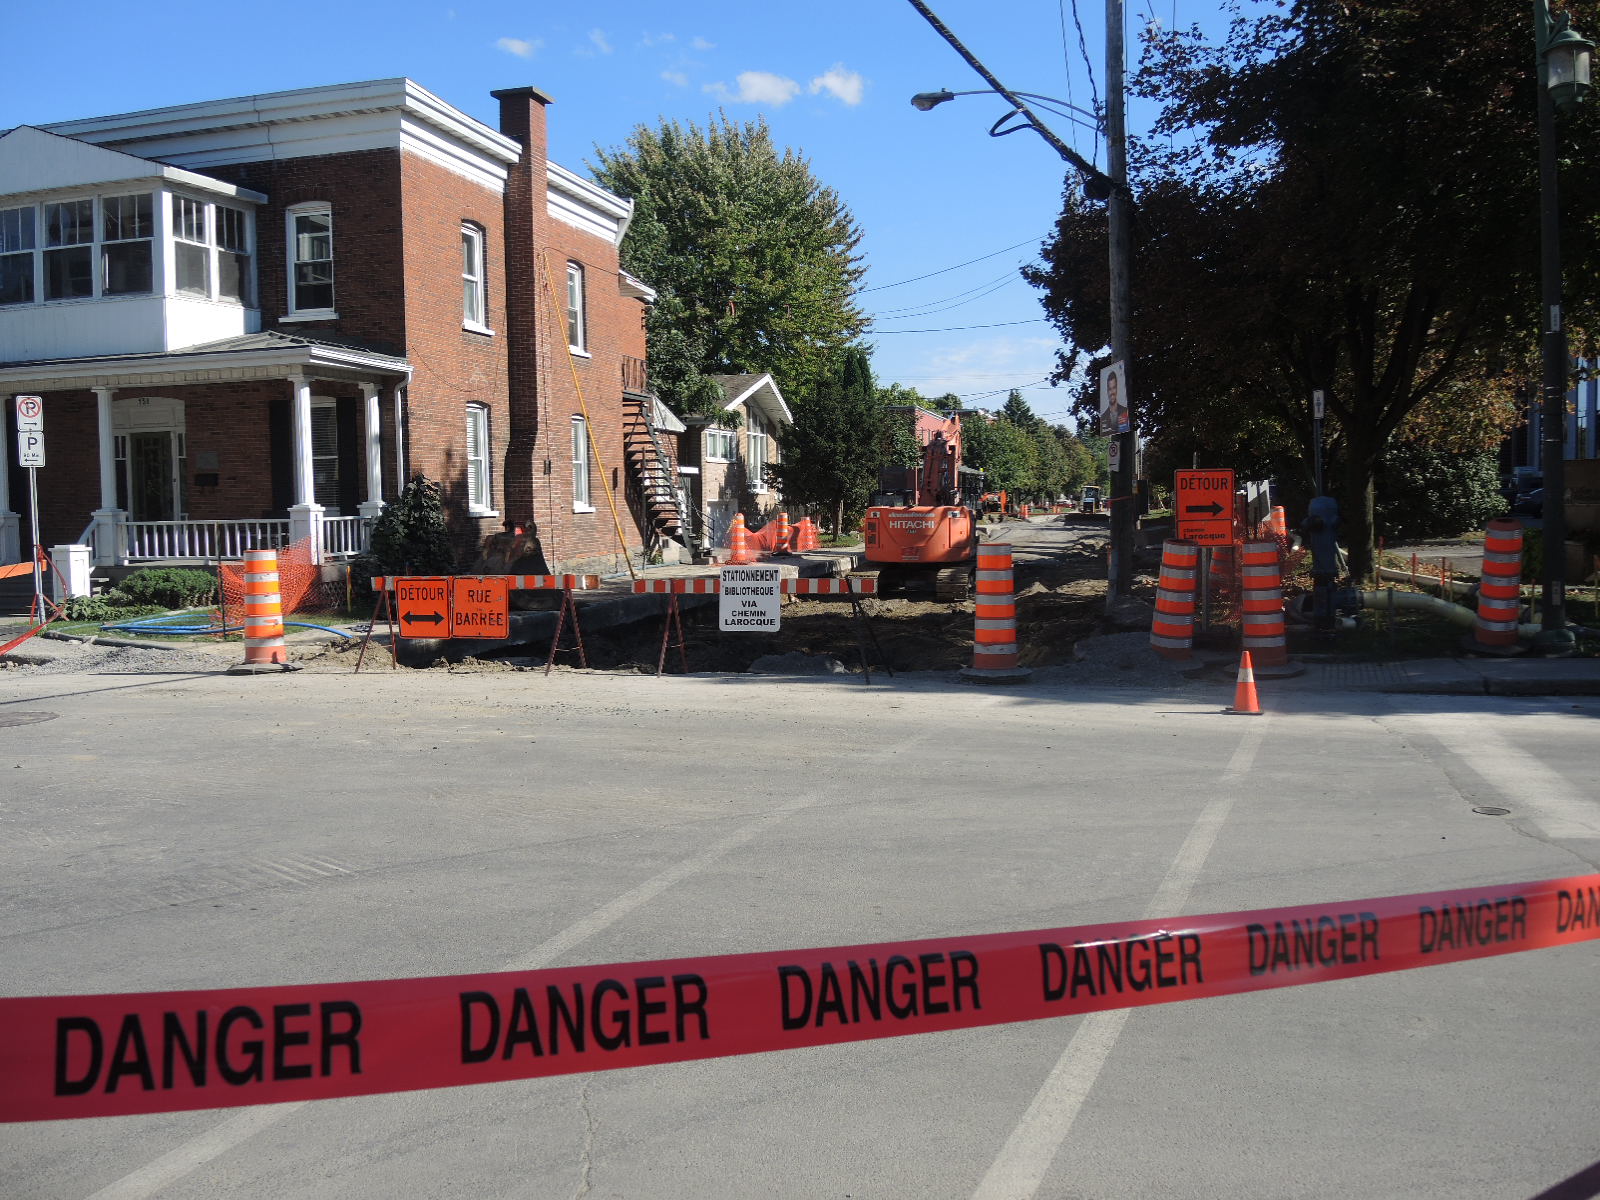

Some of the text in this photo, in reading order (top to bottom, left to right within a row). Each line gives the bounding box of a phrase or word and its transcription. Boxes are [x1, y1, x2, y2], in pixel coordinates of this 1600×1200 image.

[27, 437, 38, 450] P
[1180, 474, 1228, 490] DÉTOUR
[889, 520, 935, 529] HITACHI
[723, 570, 778, 581] STATIONNEMENT
[400, 585, 445, 601] DÉTOUR
[467, 589, 493, 603] RUE
[725, 587, 773, 595] BIBLIOTHEQUE
[741, 600, 758, 608] VIA
[455, 610, 504, 626] BARRÉE
[724, 618, 776, 627] LAROCQUE
[54, 1000, 363, 1097] DANGER
[459, 973, 711, 1065] DANGER
[777, 950, 982, 1031] DANGER
[1039, 930, 1206, 1002] DANGER
[1246, 911, 1381, 976] DANGER
[1418, 895, 1528, 953] DANGER
